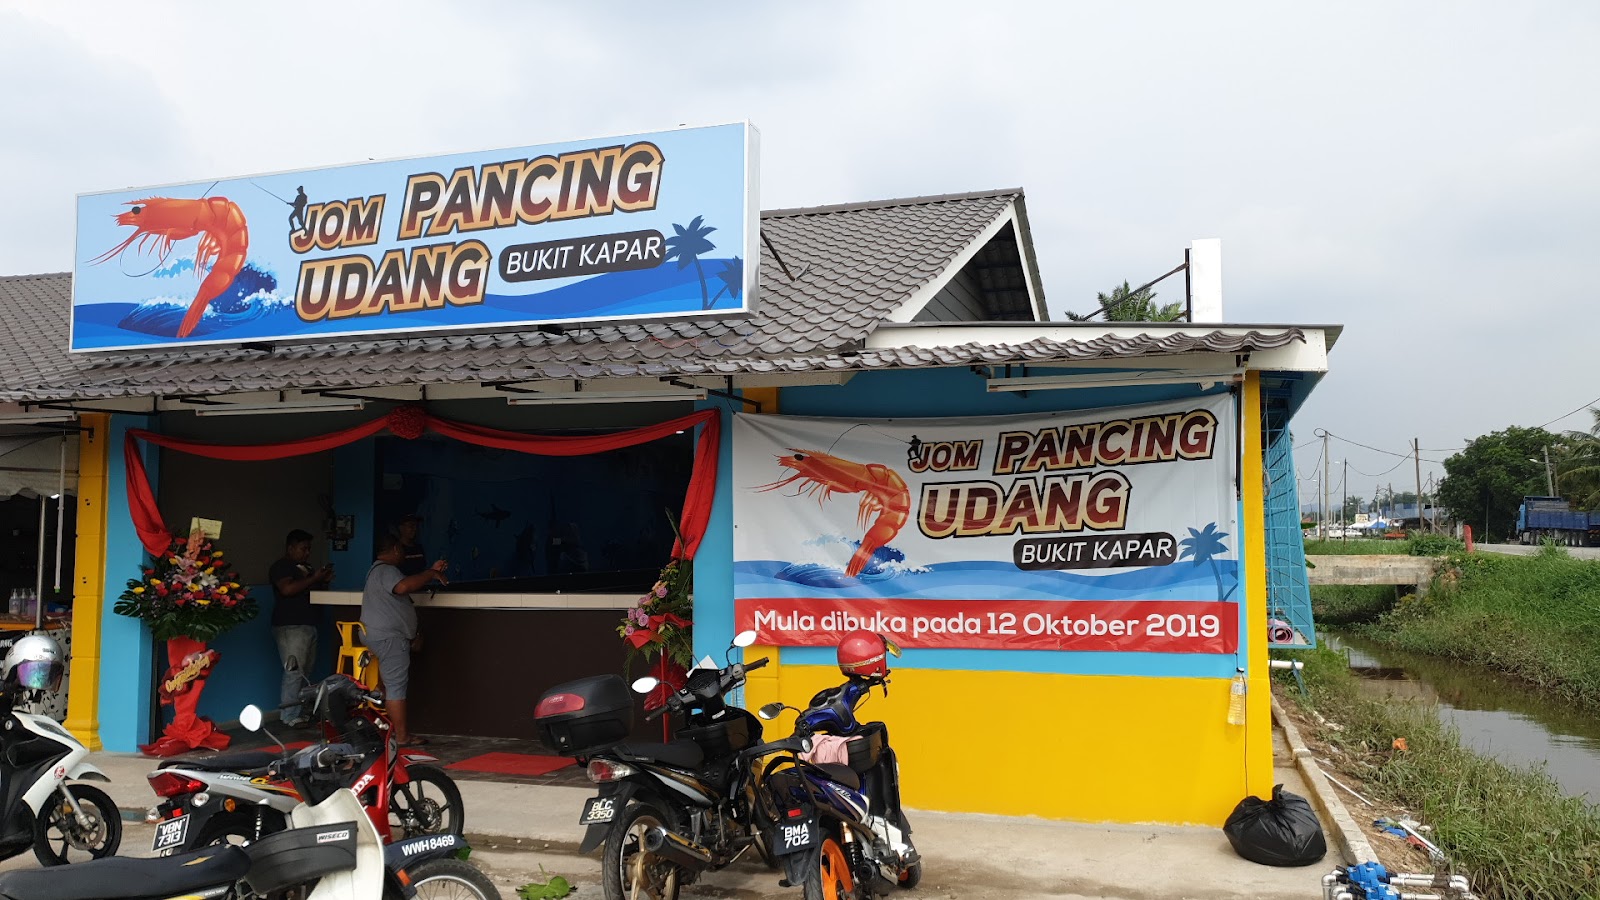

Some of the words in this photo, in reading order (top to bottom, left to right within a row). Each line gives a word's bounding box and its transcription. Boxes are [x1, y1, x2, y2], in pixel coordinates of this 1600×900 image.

[289, 194, 386, 254] JOM
[397, 141, 665, 241] PANCING
[506, 245, 574, 275] BUKIT
[579, 236, 661, 266] KAPAR
[294, 239, 492, 323] UDANG
[907, 440, 983, 473] JOM
[992, 409, 1218, 475] PANCING
[917, 469, 1133, 539] UDANG
[1021, 541, 1087, 565] BUKIT
[1092, 538, 1172, 562] KAPAR
[753, 610, 815, 632] Mula
[820, 610, 907, 633] dibuka
[913, 611, 981, 638] pada
[986, 612, 1017, 635] 12
[1022, 612, 1139, 636] Oktober
[1146, 613, 1220, 638] 2019
[587, 809, 614, 820] 3350
[591, 799, 613, 811] BLC
[158, 831, 181, 847] 7313
[318, 832, 348, 841] WISECO
[784, 823, 808, 838] BMA
[784, 834, 809, 849] 702
[401, 840, 430, 856] WWH
[430, 835, 455, 850] 8469
